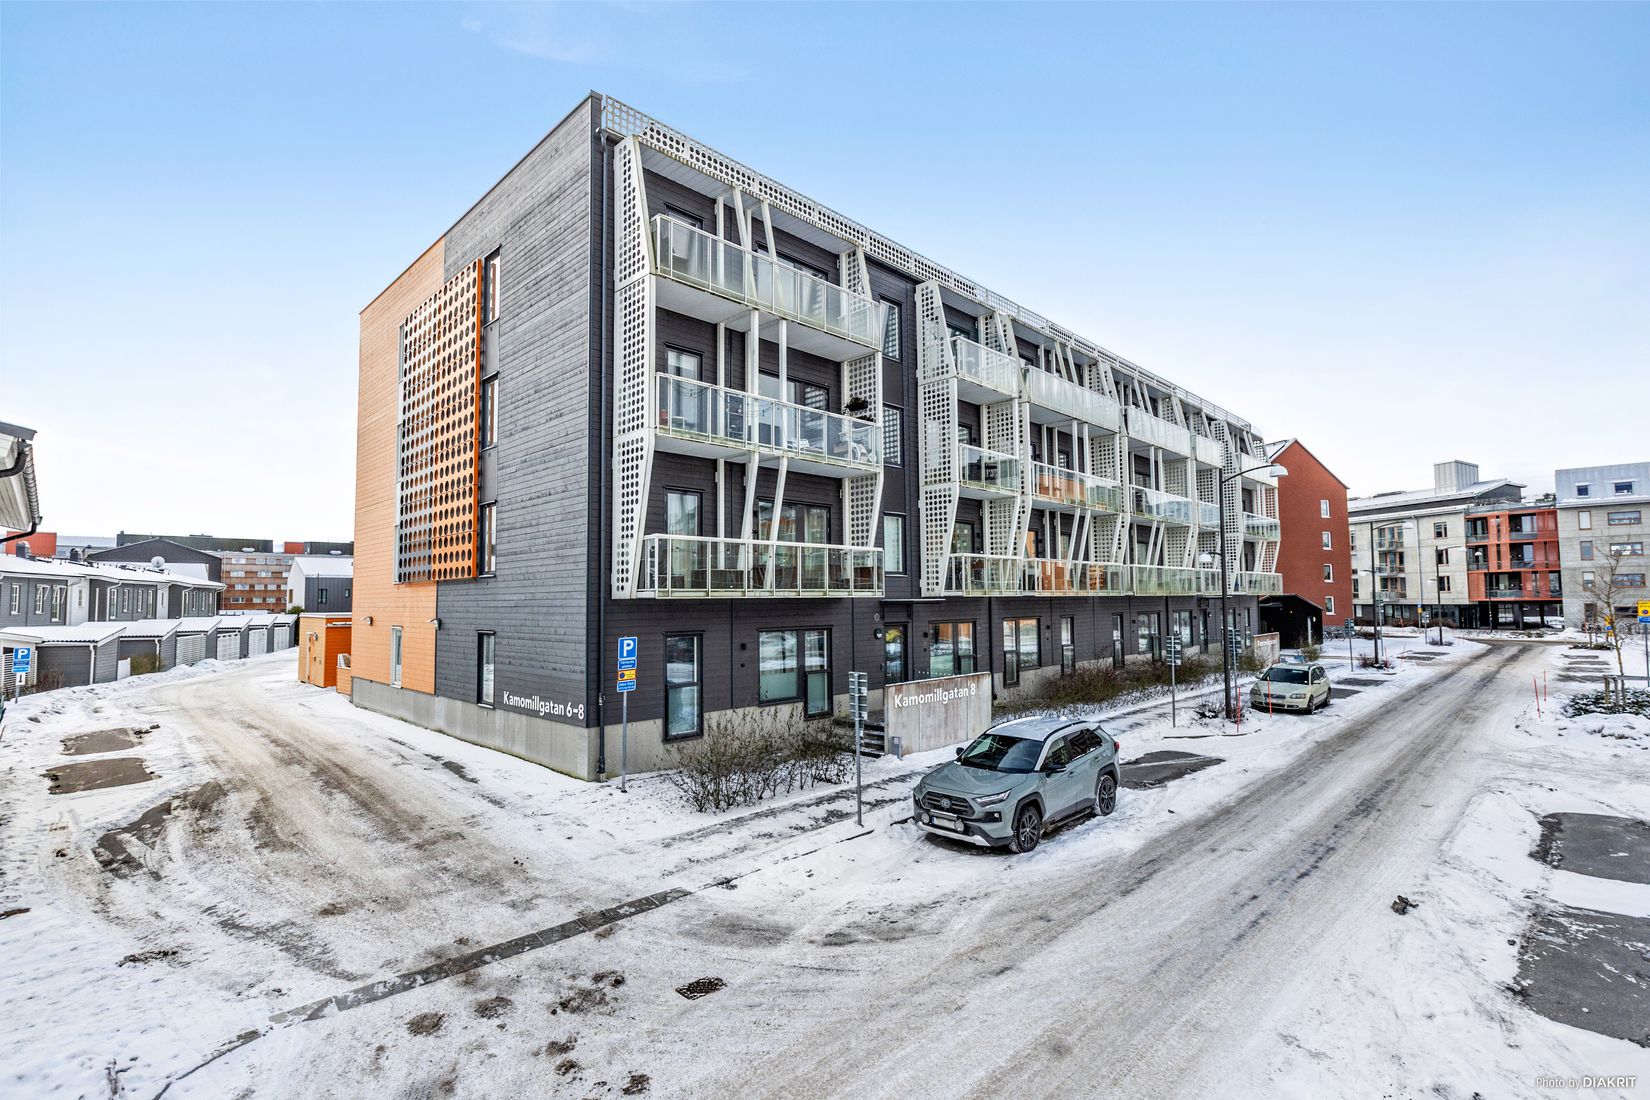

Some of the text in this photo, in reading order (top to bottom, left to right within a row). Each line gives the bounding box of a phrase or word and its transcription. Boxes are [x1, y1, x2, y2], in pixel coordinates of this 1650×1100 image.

[17, 649, 29, 659] P
[623, 639, 634, 657] P
[503, 691, 584, 720] Kamomillgatan 6-8
[895, 683, 976, 708] Kamomillgatan 8
